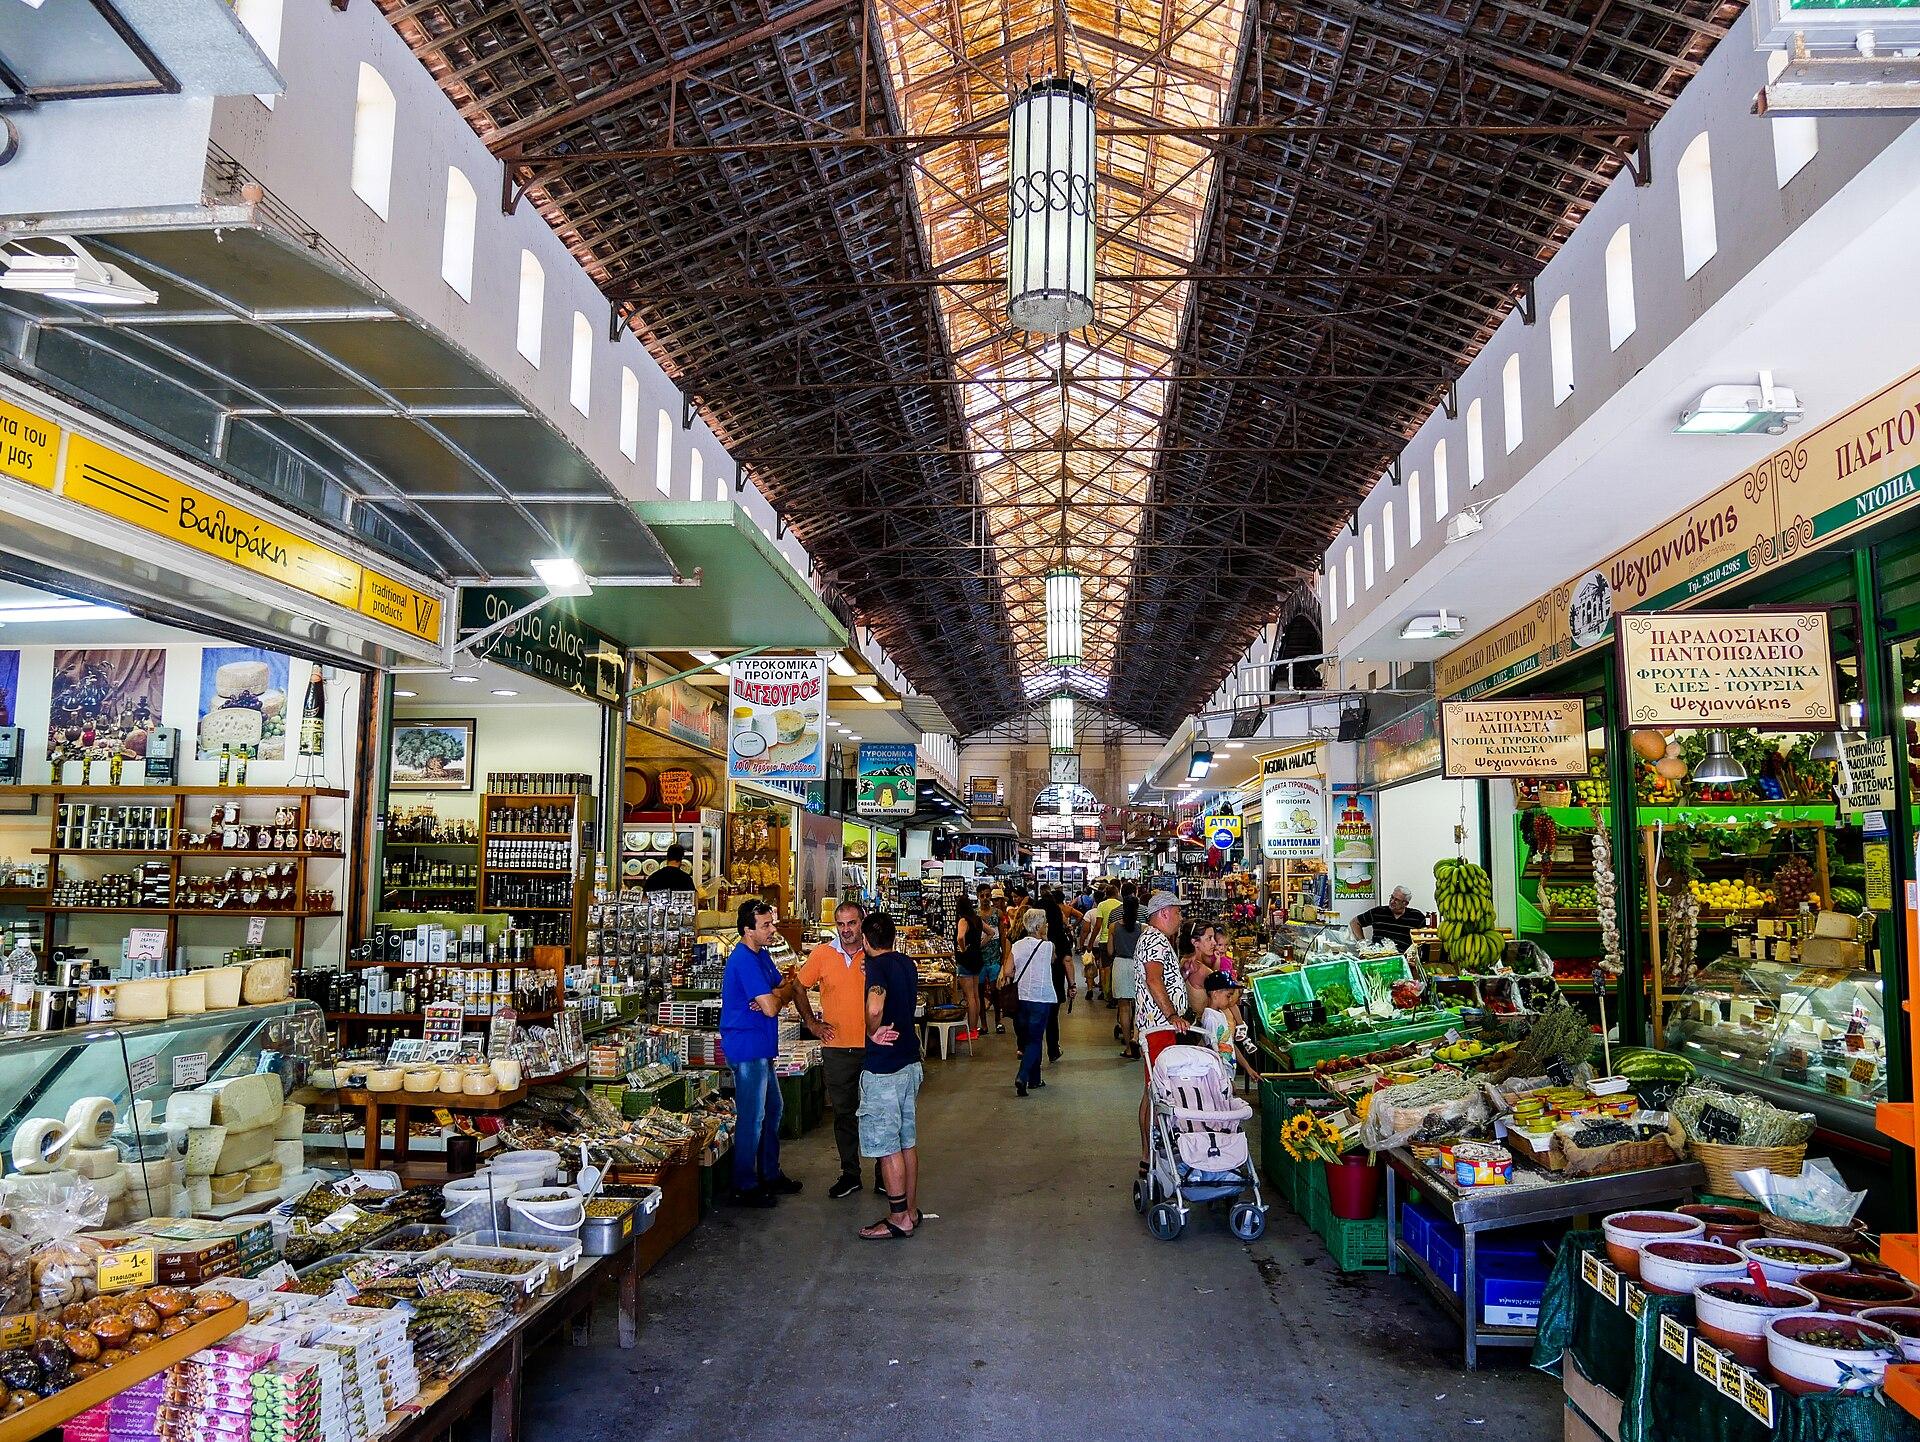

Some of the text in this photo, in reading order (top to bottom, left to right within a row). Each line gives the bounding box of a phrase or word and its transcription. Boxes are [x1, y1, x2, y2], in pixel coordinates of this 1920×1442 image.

[24, 426, 46, 447] του
[1835, 402, 1920, 481] ΠΑΣΤΟ
[8, 445, 32, 469] μας
[1855, 473, 1915, 517] ΝΤΟΠΙΑ
[179, 497, 288, 568] Βαλυράκη
[1702, 569, 1721, 586] 28210
[1721, 559, 1740, 576] 42985
[372, 582, 407, 608] traditional
[373, 600, 403, 622] products
[485, 594, 542, 642] αρμα
[1651, 627, 1800, 646] ΠΑΡΑΔΟΣΙΑΚΟ
[1650, 644, 1804, 662] ΠΑΝΤΟΠΩΛΕΙΟ
[736, 660, 818, 670] ΤΥΡΟΚΟΜΙΚΑ
[1637, 665, 1820, 680] ΦΡΟΥΤΑ ΛΑΧΑΝΙΚΑ
[734, 676, 820, 706] ΠΑΤΣΟΥΡΟΣ
[1654, 680, 1805, 693] ΕΛΙΕΣ ΤΟΥΡΣΙΑ
[1465, 710, 1563, 723] ΠΑΣΤΟΥΡΜΑΣ
[1478, 722, 1550, 734] ΑΛΙΠΑΣΤΑ
[1451, 736, 1495, 746] ΝΤΟΠΙΑ
[1486, 745, 1545, 755] ΚΑΠΝΙΣΤΑ
[860, 750, 913, 758] ΤΥΡΟΚΟΜΙΚΑ
[1264, 751, 1317, 775] AGORA PALACE
[1848, 793, 1881, 807] ΚΟΣΜΙΔΗ
[1209, 818, 1237, 826] ATM
